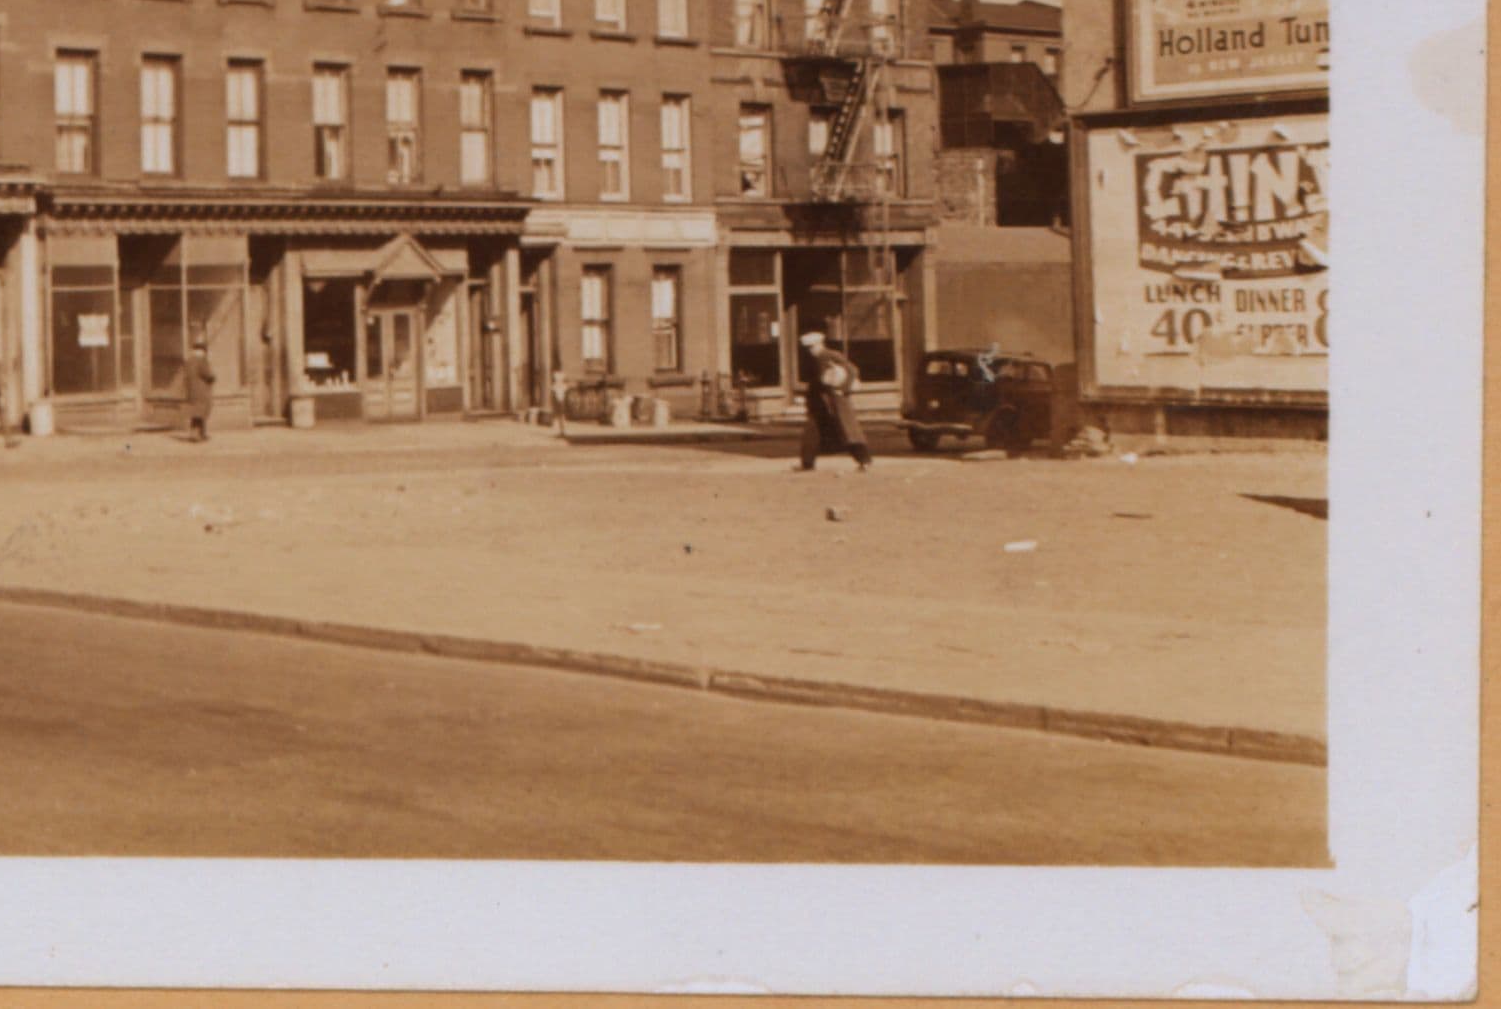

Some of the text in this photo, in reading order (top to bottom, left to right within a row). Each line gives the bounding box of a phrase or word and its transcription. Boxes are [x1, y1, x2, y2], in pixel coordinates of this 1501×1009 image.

[1158, 16, 1330, 57] Holland Tun
[1145, 283, 1221, 304] LUNCH
[1236, 288, 1307, 313] DINNER
